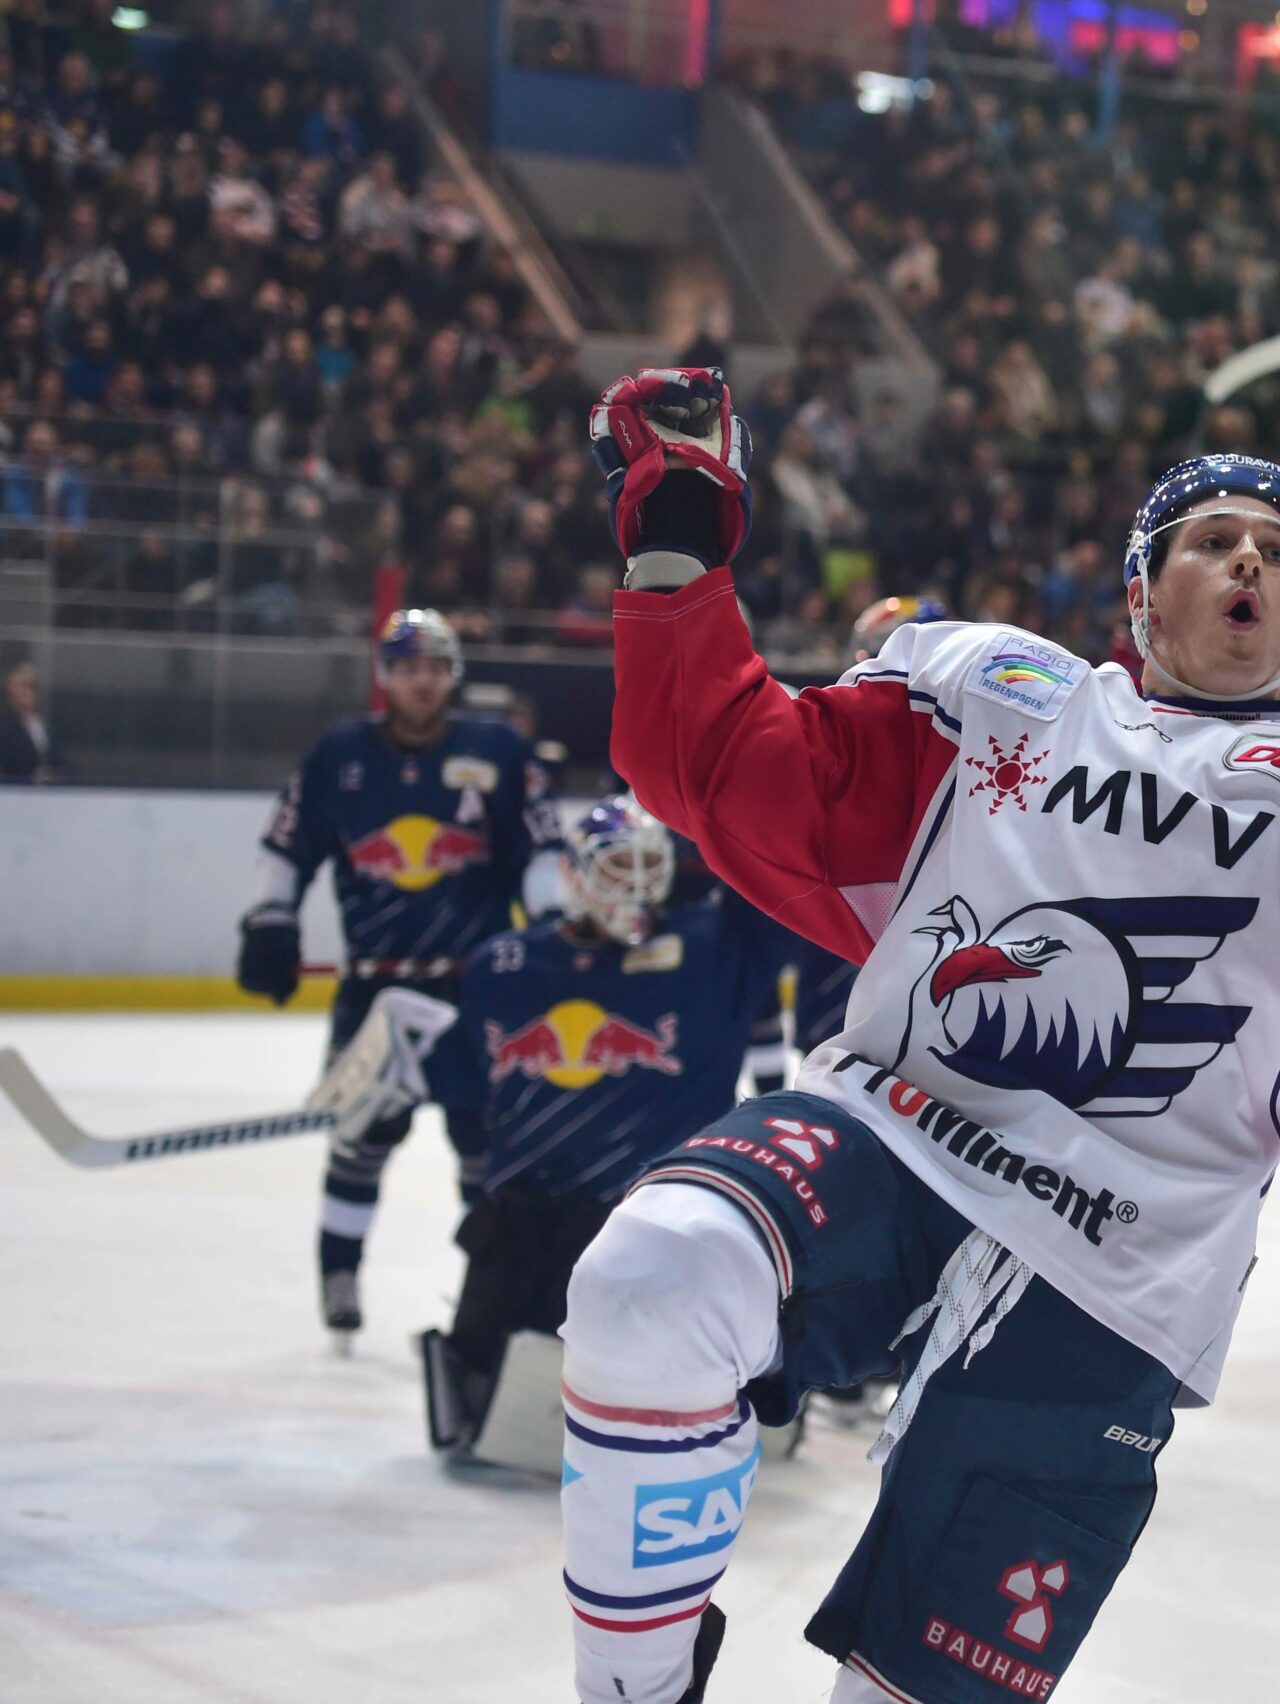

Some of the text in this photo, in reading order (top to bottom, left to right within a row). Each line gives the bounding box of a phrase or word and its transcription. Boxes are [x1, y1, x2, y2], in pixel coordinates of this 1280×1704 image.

[1010, 638, 1071, 671] RADIO
[981, 679, 1045, 711] REGENBOGEN
[1041, 766, 1276, 870] MVV
[686, 1138, 825, 1224] BAUHAUS
[927, 1620, 1053, 1697] BAUHAUS
